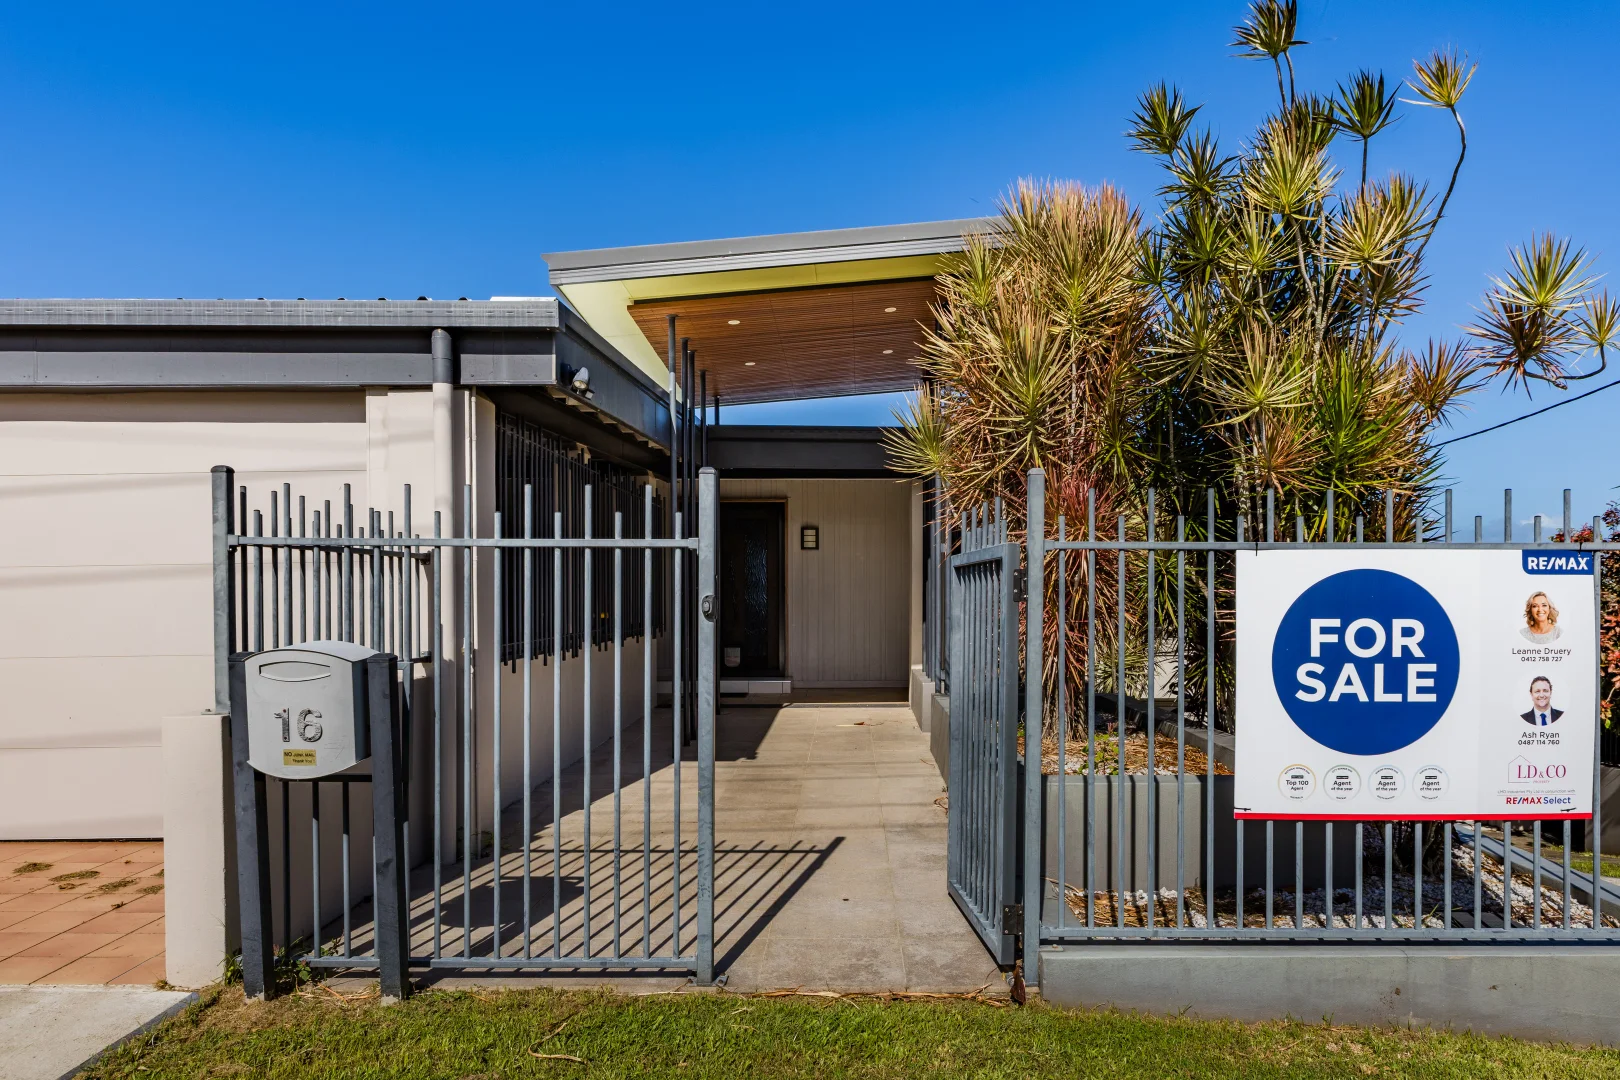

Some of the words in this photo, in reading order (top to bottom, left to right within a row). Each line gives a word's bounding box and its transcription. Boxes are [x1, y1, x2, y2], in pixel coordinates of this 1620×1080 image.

[1527, 556, 1589, 570] RE/MAX
[1310, 618, 1425, 658] FOR
[1511, 647, 1542, 655] Leanne
[1544, 647, 1572, 656] Druery
[1295, 662, 1437, 702] SALE
[274, 707, 323, 742] 16
[1521, 731, 1537, 739] Ash
[1539, 731, 1560, 740] Ryan
[1505, 796, 1543, 805] RE/MAX
[1543, 796, 1571, 805] Select
